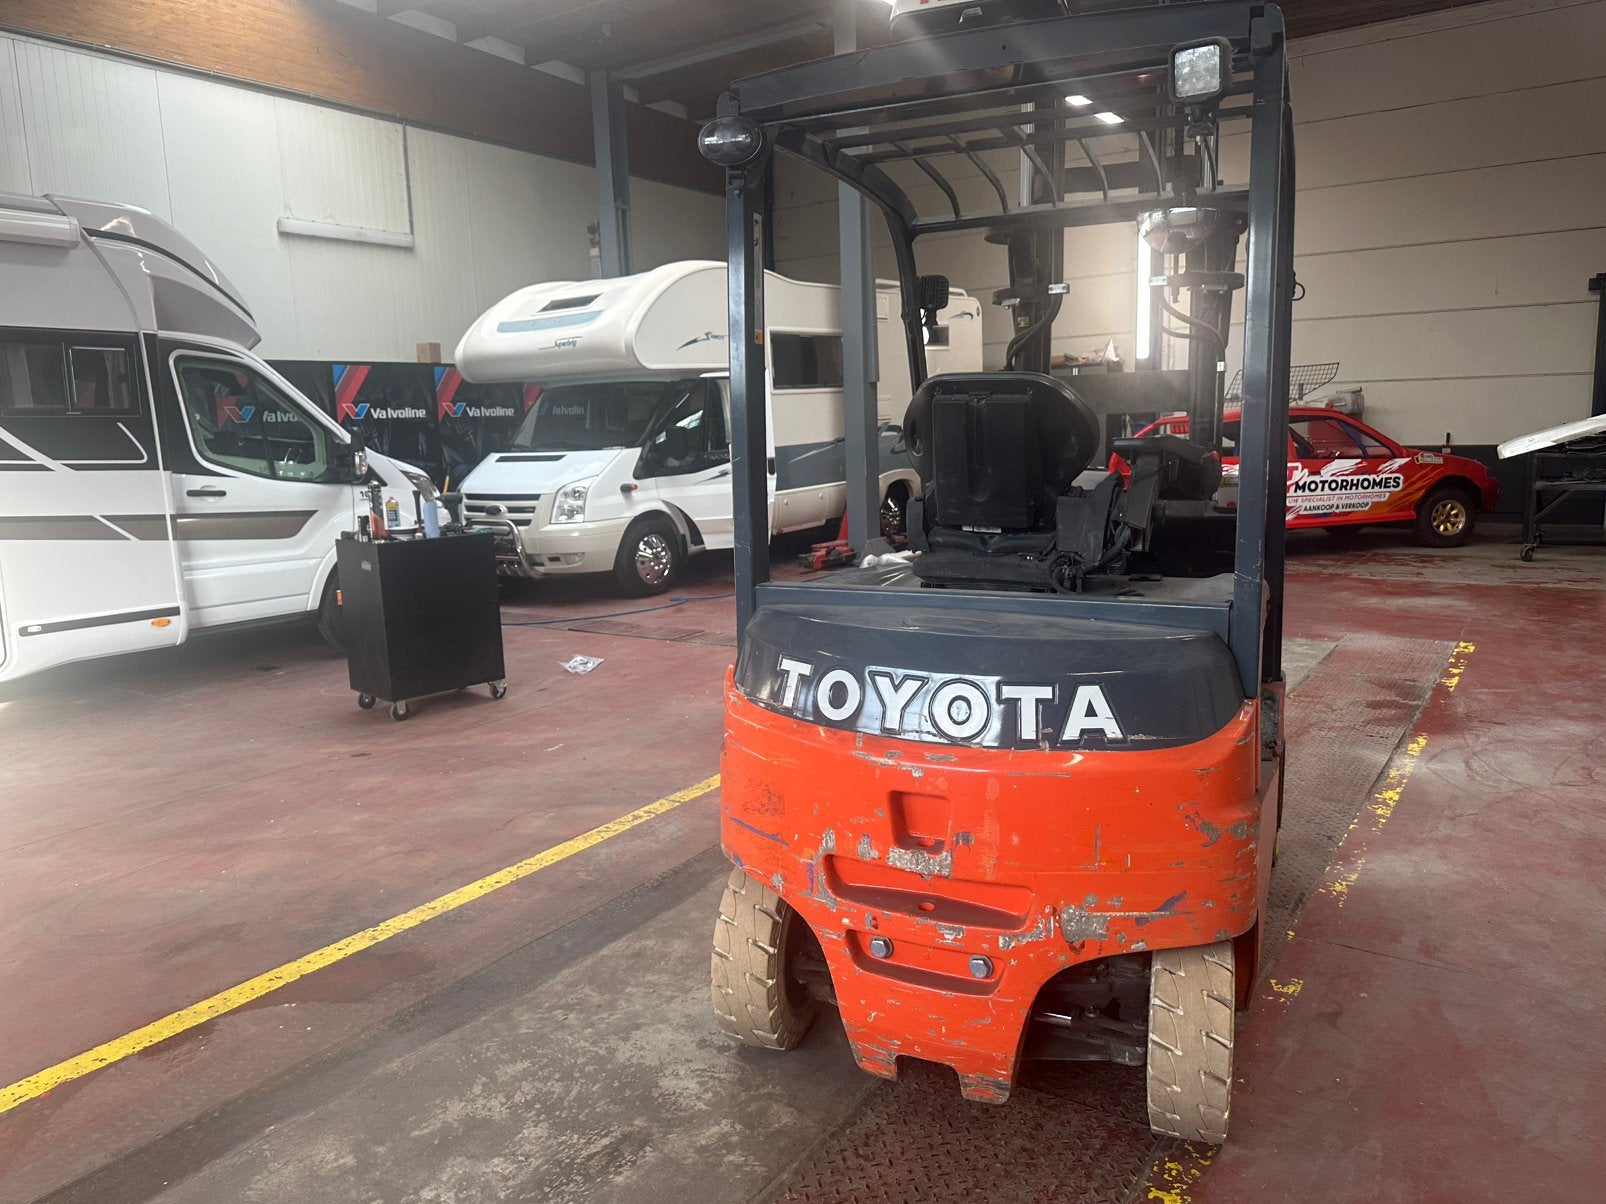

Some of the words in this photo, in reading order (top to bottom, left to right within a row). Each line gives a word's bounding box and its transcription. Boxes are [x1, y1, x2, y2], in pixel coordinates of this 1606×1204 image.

[370, 407, 426, 419] Valvoline
[466, 406, 515, 417] Valvoline
[1294, 476, 1401, 493] MOTORHOMES
[1344, 493, 1387, 501] MOTORHOMES
[1303, 503, 1335, 512] AANKOOP
[1341, 501, 1370, 511] VERKOOP
[778, 655, 1127, 742] TOYOTA
